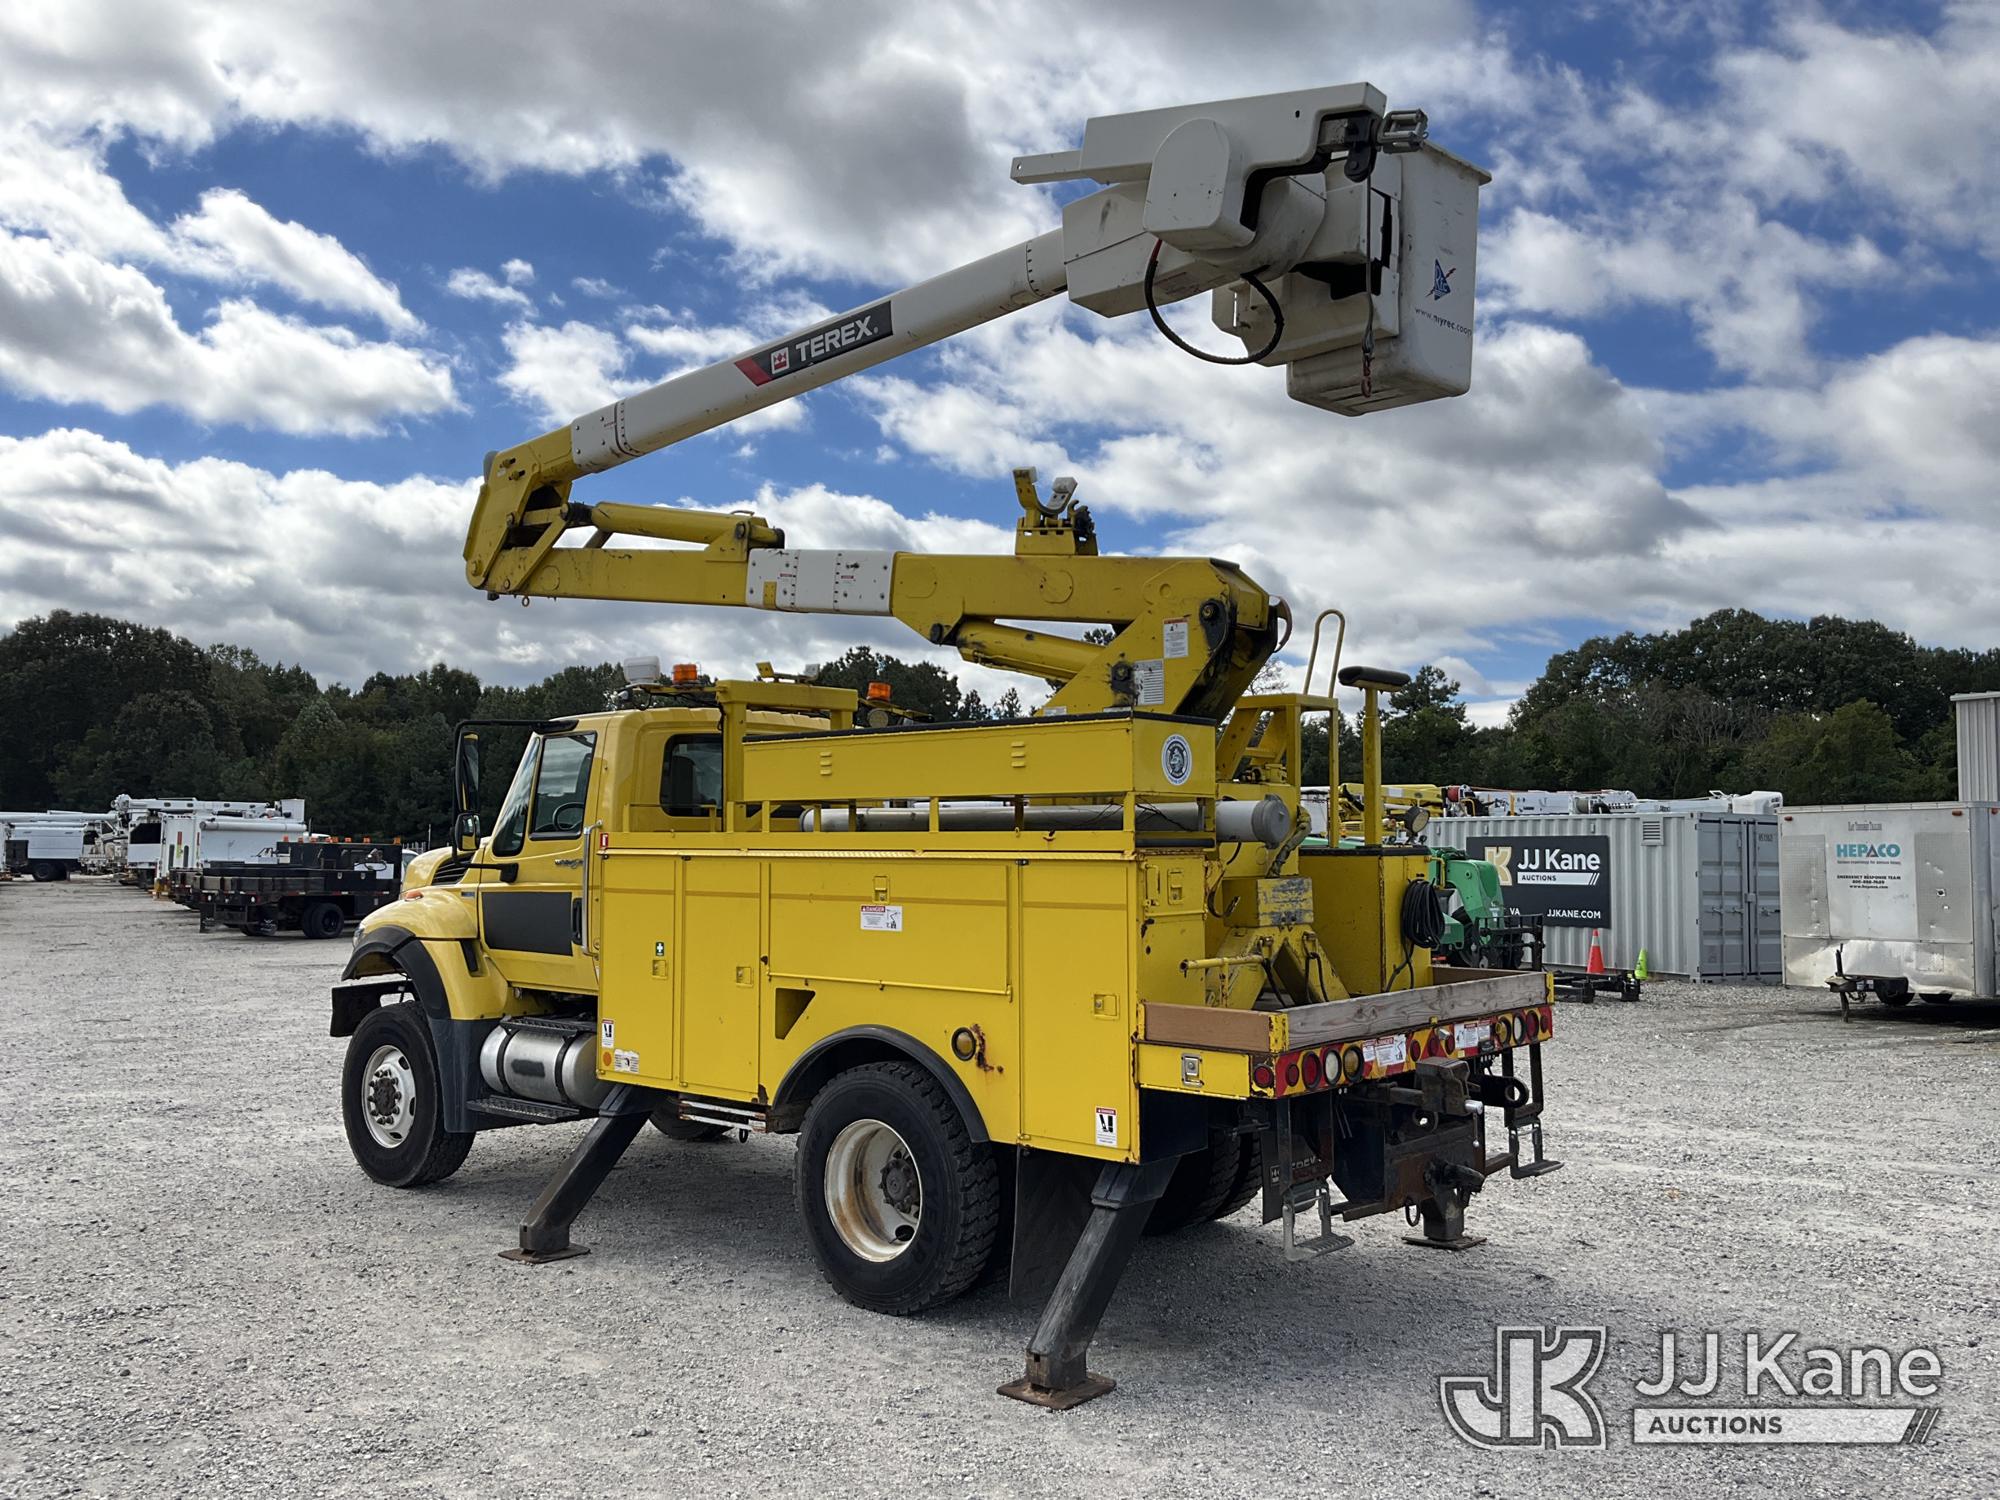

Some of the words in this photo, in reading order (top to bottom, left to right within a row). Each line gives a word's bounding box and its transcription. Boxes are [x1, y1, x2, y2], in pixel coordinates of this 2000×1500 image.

[796, 315, 873, 361] TEREX
[1836, 843, 1901, 858] HEPACO
[1517, 848, 1540, 870] JJ
[1545, 848, 1600, 871] Kane
[1521, 874, 1557, 882] AUCTIONS
[1509, 907, 1520, 916] VA
[1546, 908, 1601, 919] JJKANE.COM
